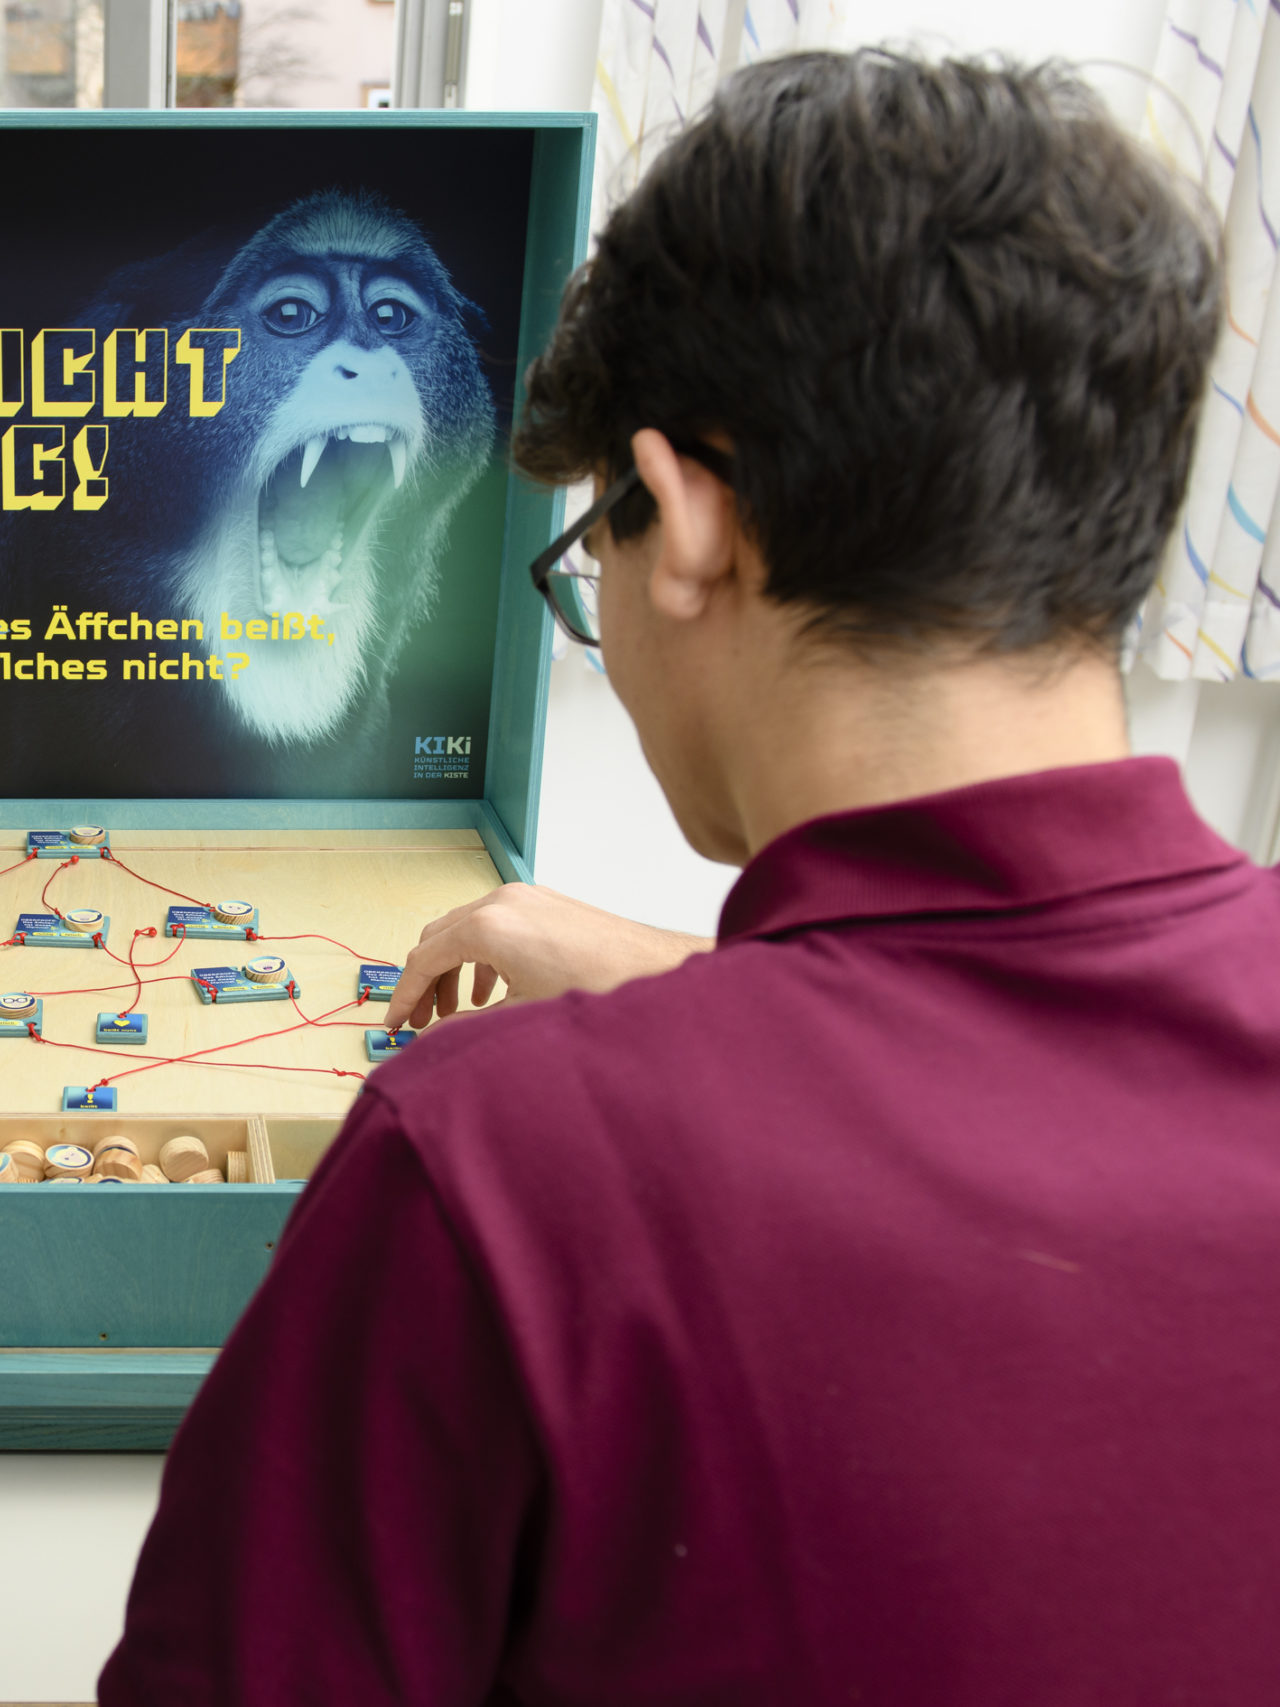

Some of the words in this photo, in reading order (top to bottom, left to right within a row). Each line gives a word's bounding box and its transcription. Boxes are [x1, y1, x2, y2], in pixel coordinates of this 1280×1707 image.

[44, 605, 204, 640] Äffchen
[220, 611, 335, 645] beißt,
[123, 652, 251, 680] nicht?
[414, 736, 472, 755] KIKi
[443, 771, 469, 779] KISTE
